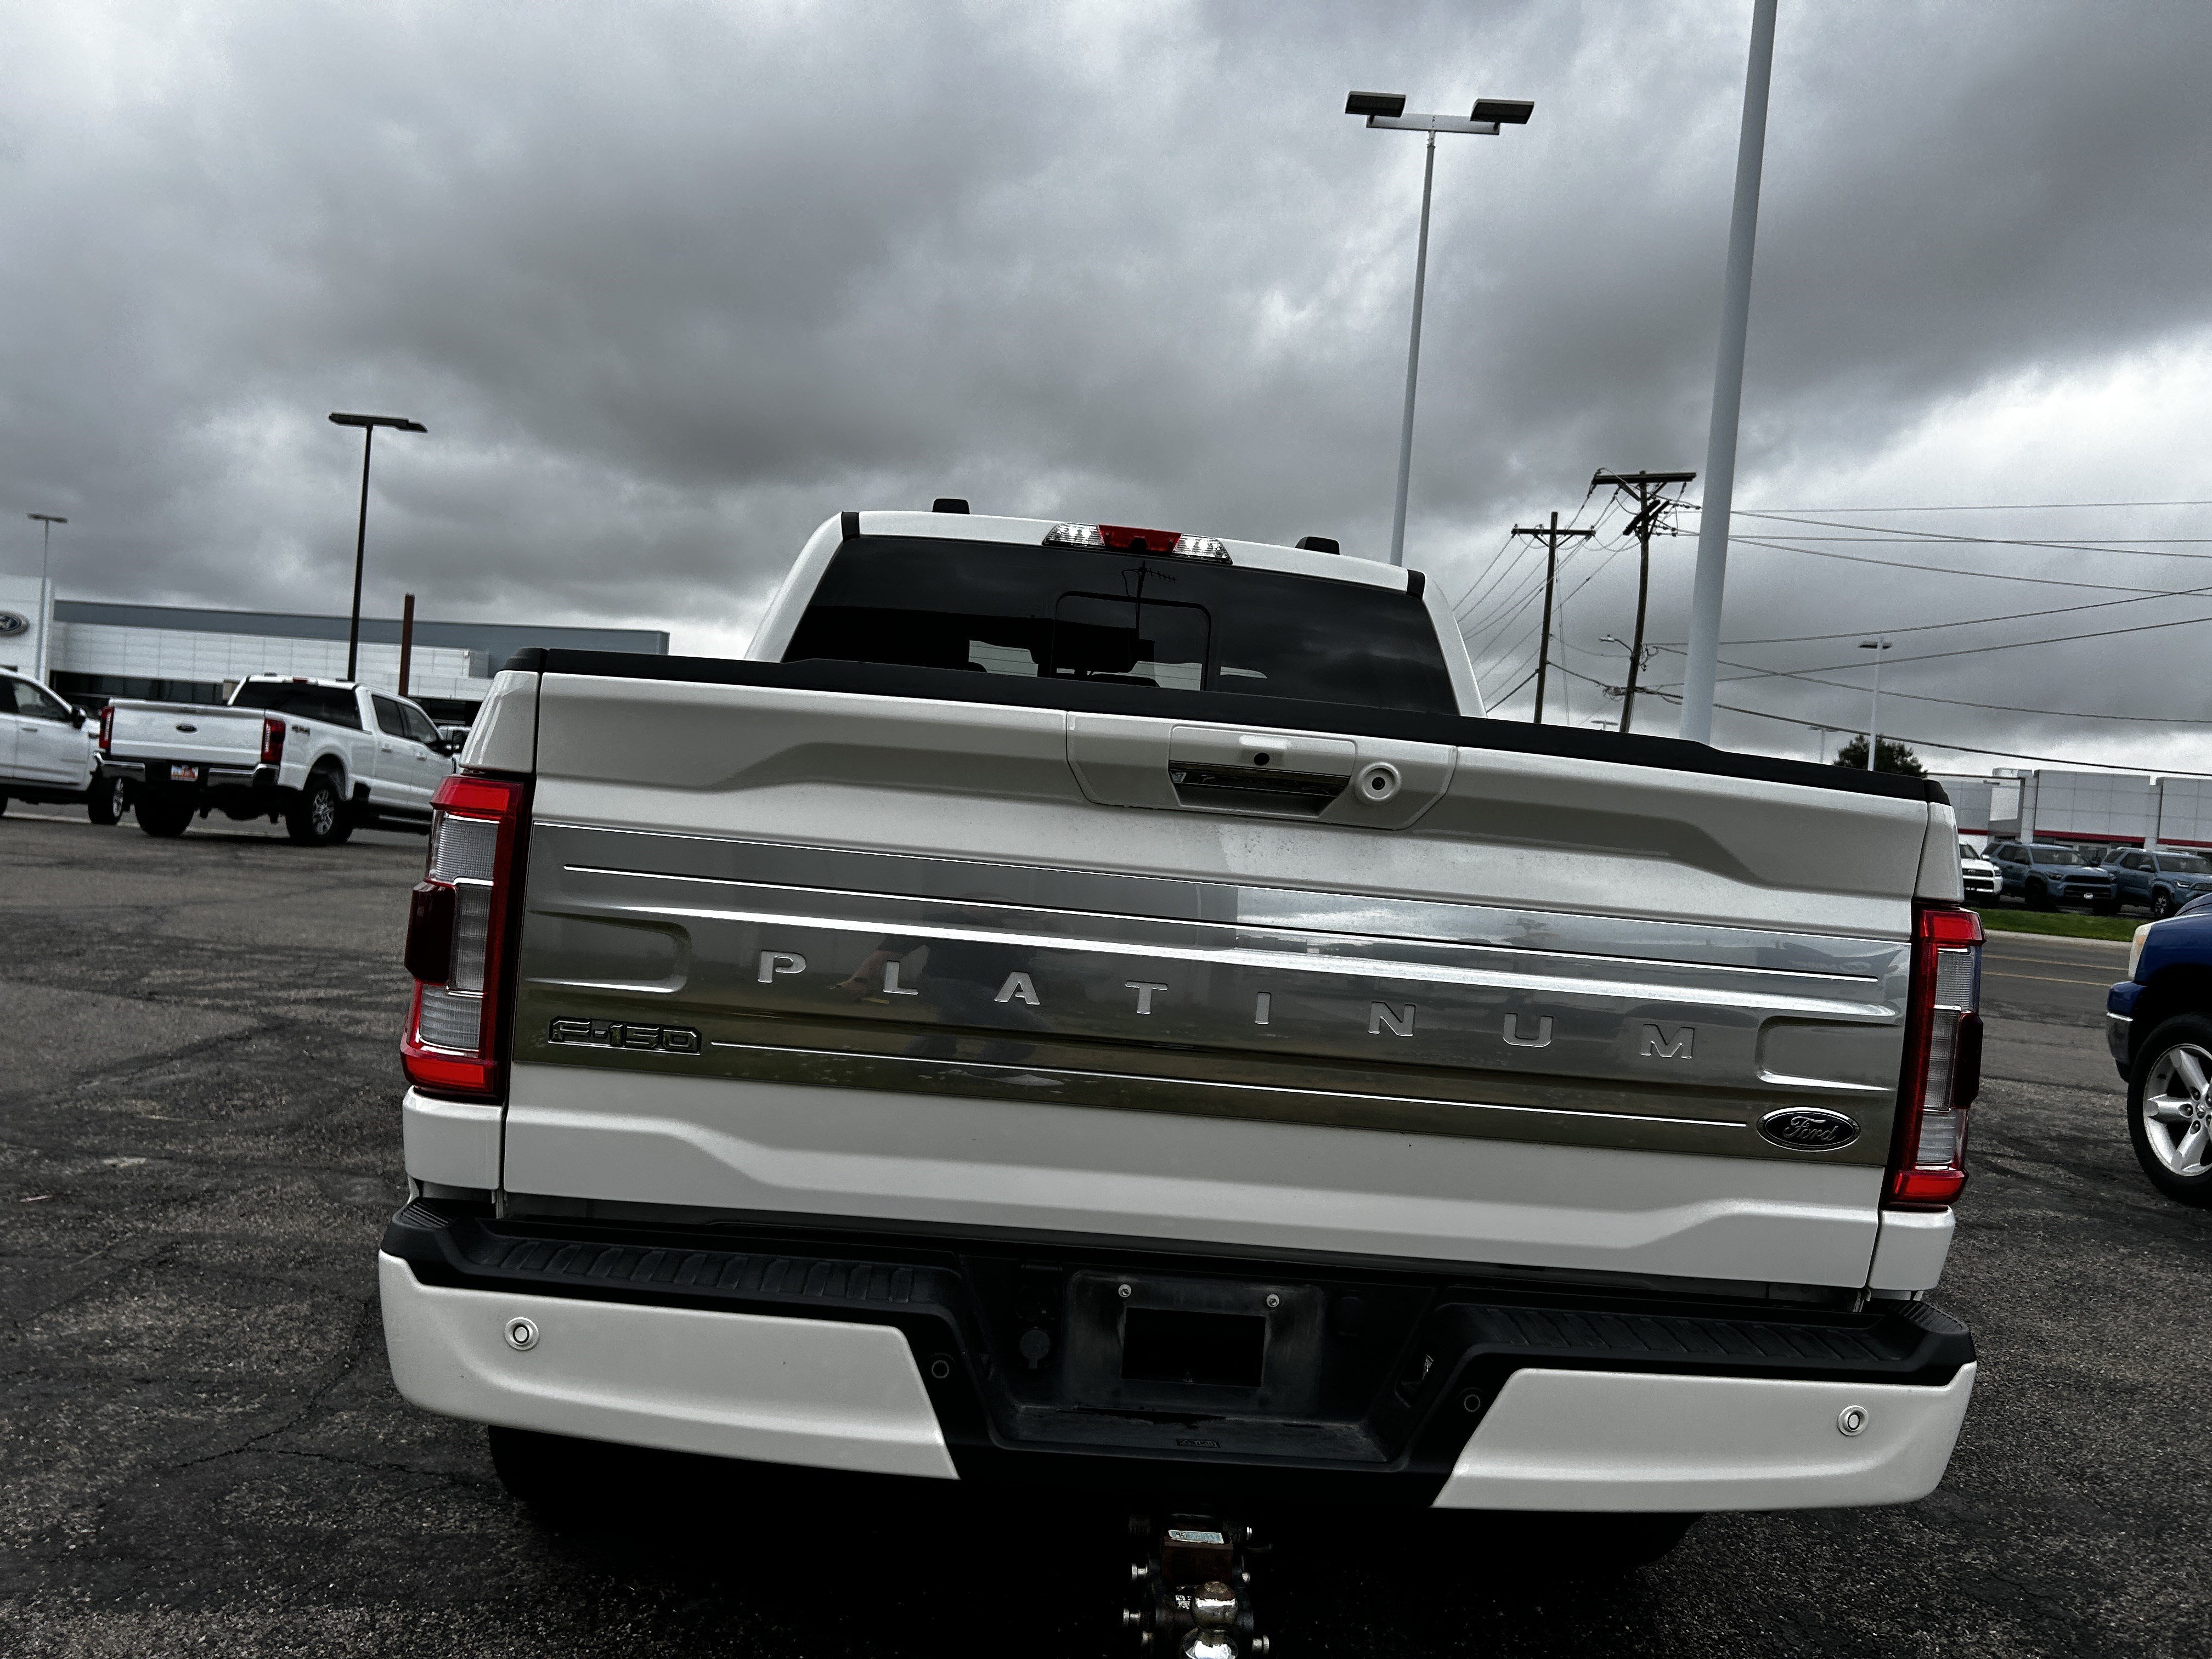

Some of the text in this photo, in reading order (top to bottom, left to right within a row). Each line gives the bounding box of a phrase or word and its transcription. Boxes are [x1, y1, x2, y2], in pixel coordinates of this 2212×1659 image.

[757, 949, 1695, 1059] PLATINUM
[548, 1015, 702, 1056] F-150
[1784, 1116, 1839, 1141] Ford
